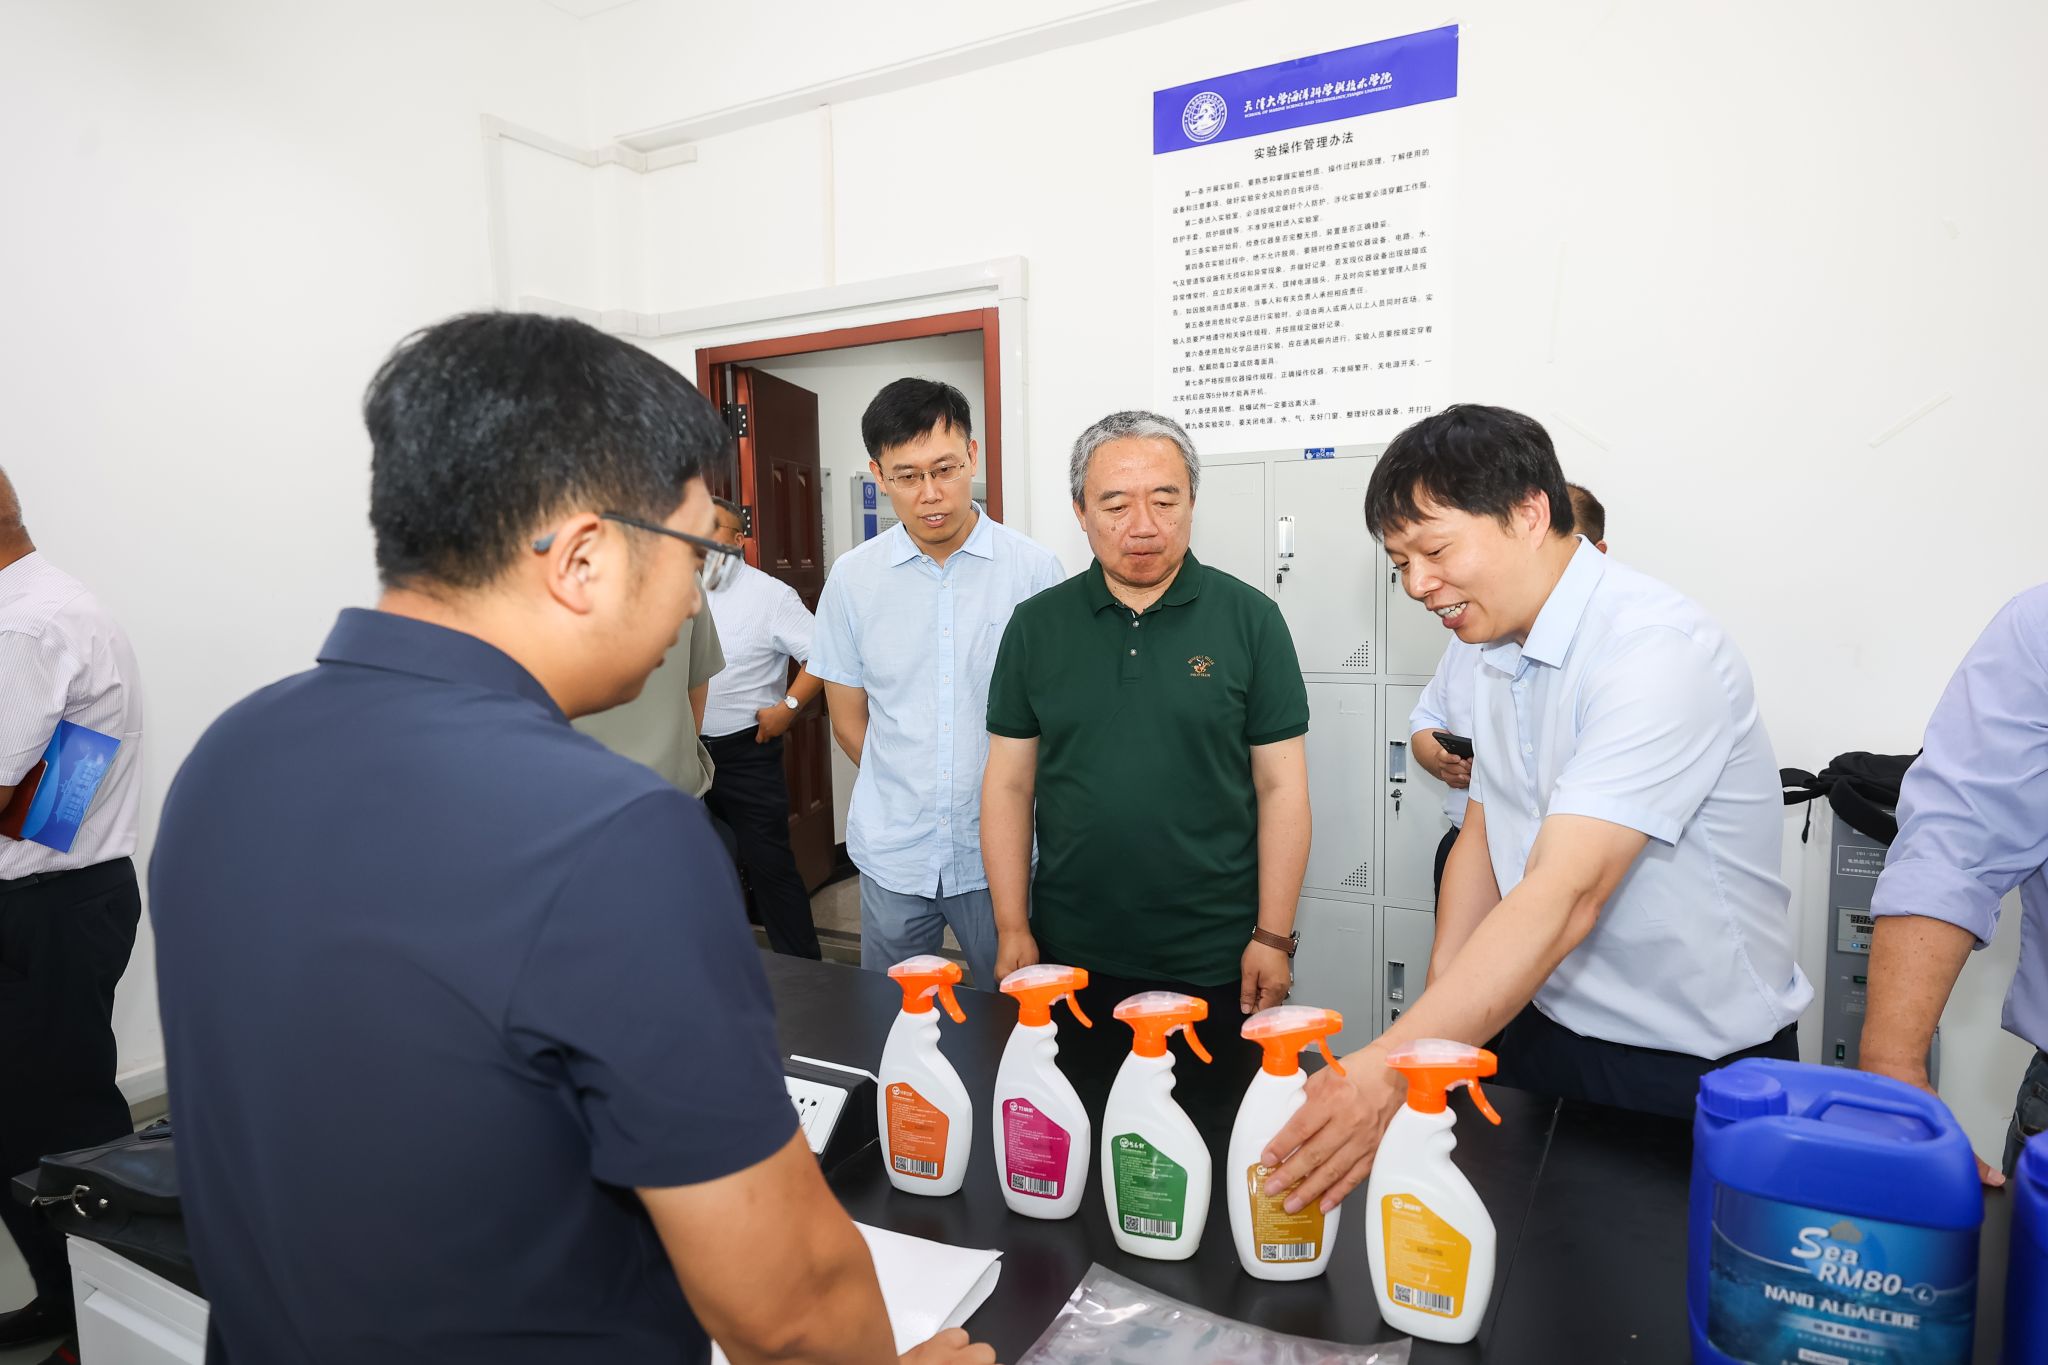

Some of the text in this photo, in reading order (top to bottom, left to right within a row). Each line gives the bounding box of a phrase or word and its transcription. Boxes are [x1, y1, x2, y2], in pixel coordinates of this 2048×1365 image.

[1253, 131, 1354, 160] 实验操作管理办法
[1790, 1227, 1859, 1265] Sea
[1765, 1284, 1921, 1330] NANO ALGAECIDE
